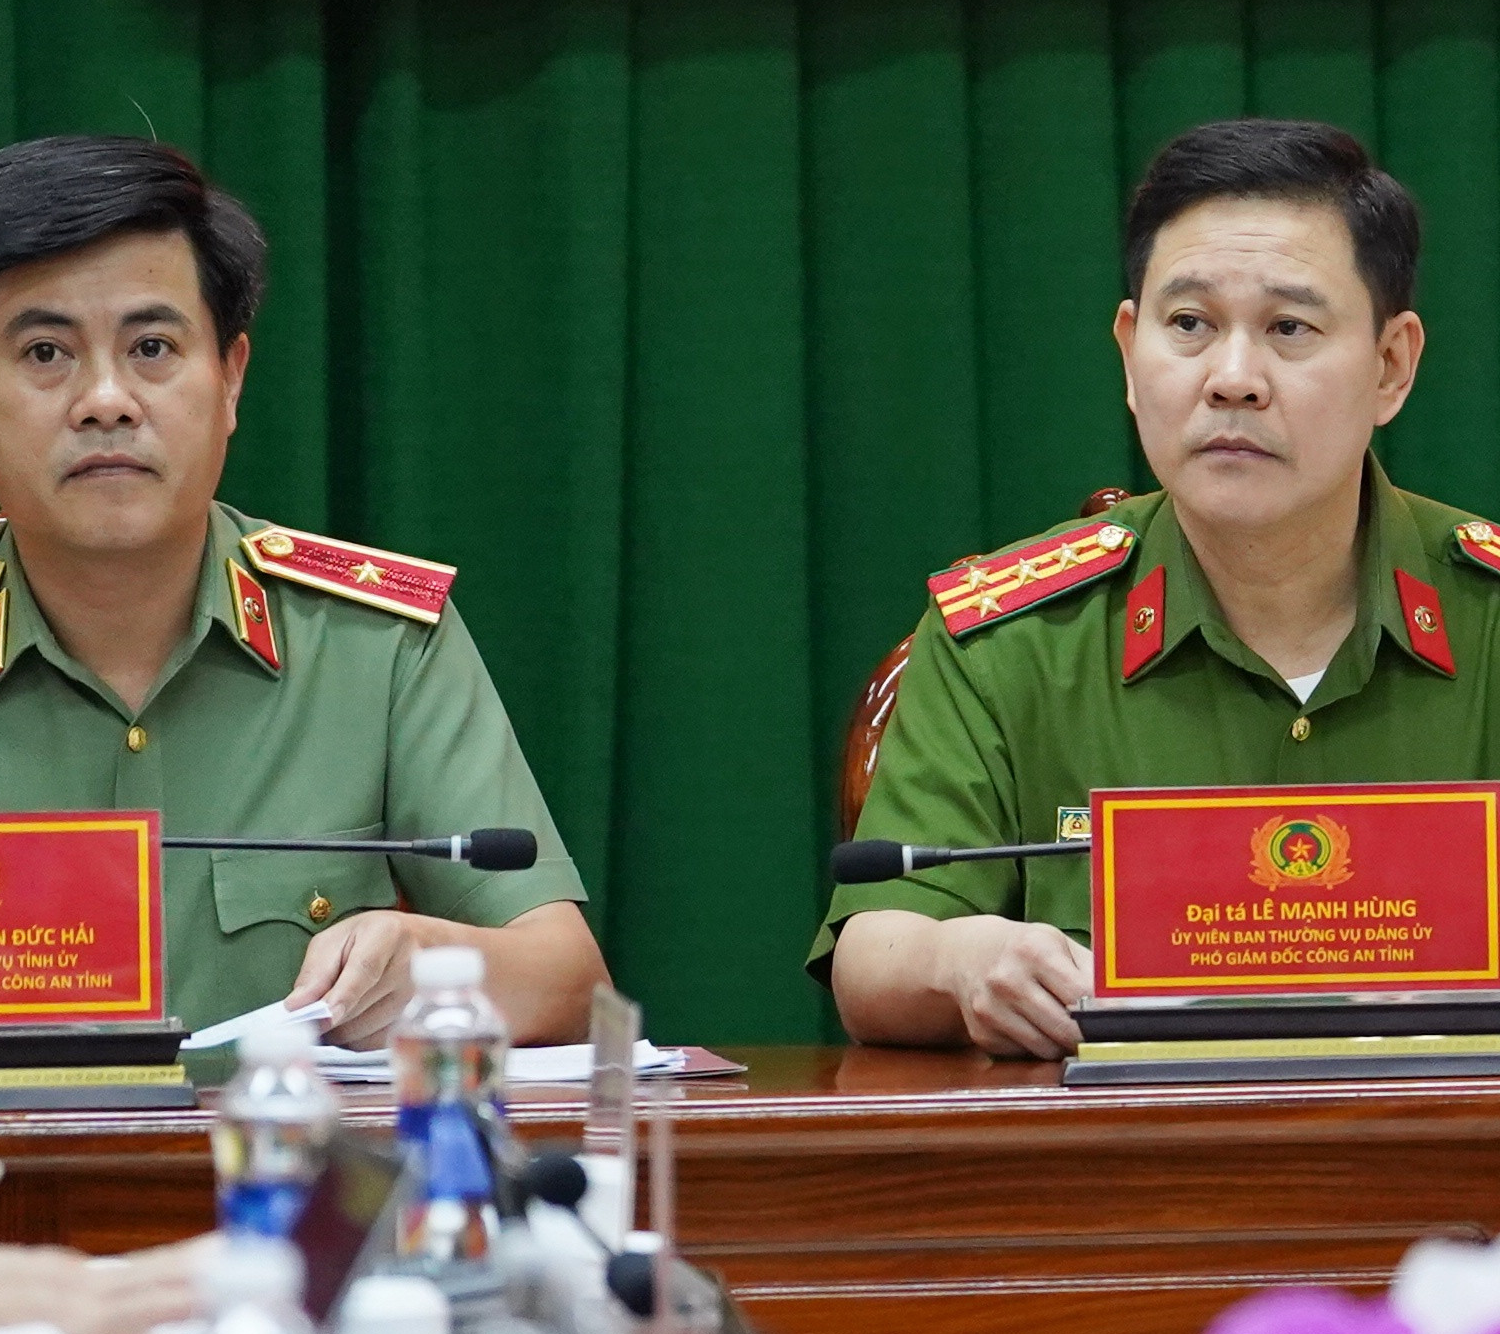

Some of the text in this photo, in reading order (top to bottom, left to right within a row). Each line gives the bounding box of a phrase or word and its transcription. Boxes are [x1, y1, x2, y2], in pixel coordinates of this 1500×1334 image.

[1187, 895, 1417, 925] Đại tá LÊ MẠNH HÙNG
[11, 925, 56, 947] ĐỨC
[61, 922, 95, 945] HẢI
[1171, 922, 1433, 946] ỦY VIÊN BAN THƯỜNG VỤ ĐẢNG ỦY
[17, 950, 55, 969] TỈNH
[57, 949, 79, 968] ỦY
[1190, 944, 1414, 965] PHÓ GIÁM ĐỐC CÔNG AN TỈNH
[1, 972, 47, 990] CÔNG
[49, 974, 72, 989] AN
[75, 970, 113, 989] TỈNH
